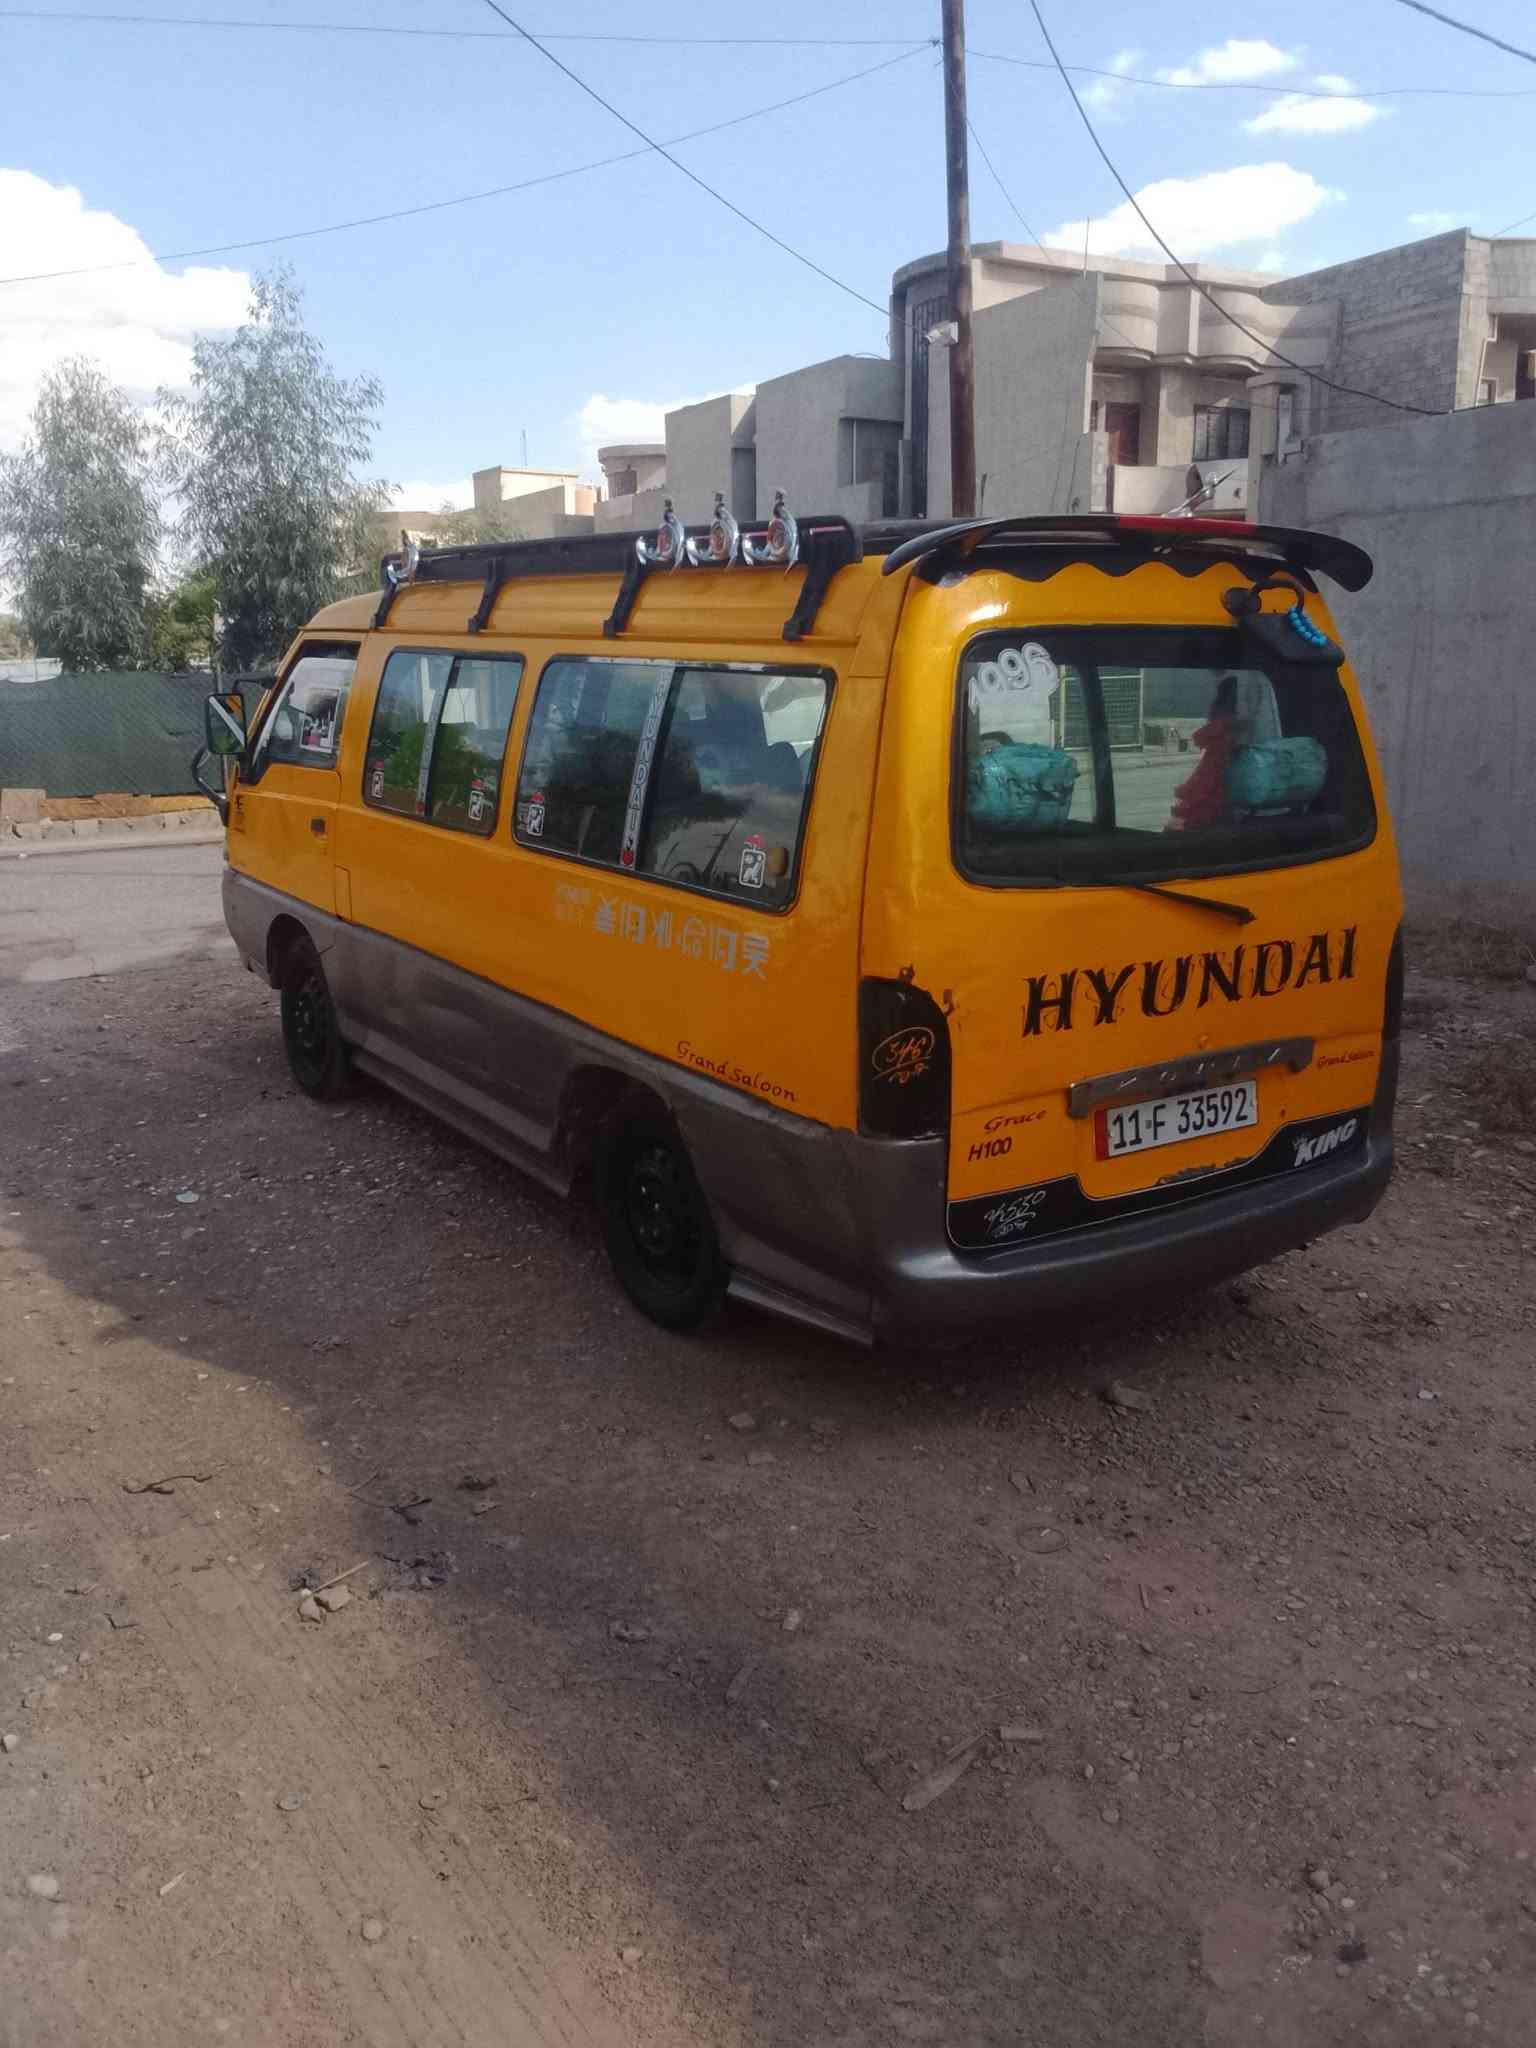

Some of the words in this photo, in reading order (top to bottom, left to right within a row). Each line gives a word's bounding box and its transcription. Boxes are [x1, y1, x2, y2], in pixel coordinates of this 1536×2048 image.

[1021, 924, 1358, 1038] HYUNDAI
[677, 1041, 728, 1075] Grand
[728, 1067, 796, 1102] Saloon
[984, 1109, 1047, 1134] Grace
[1177, 1088, 1249, 1135] 33592
[968, 1136, 1012, 1162] H100
[1294, 1118, 1357, 1167] KING
